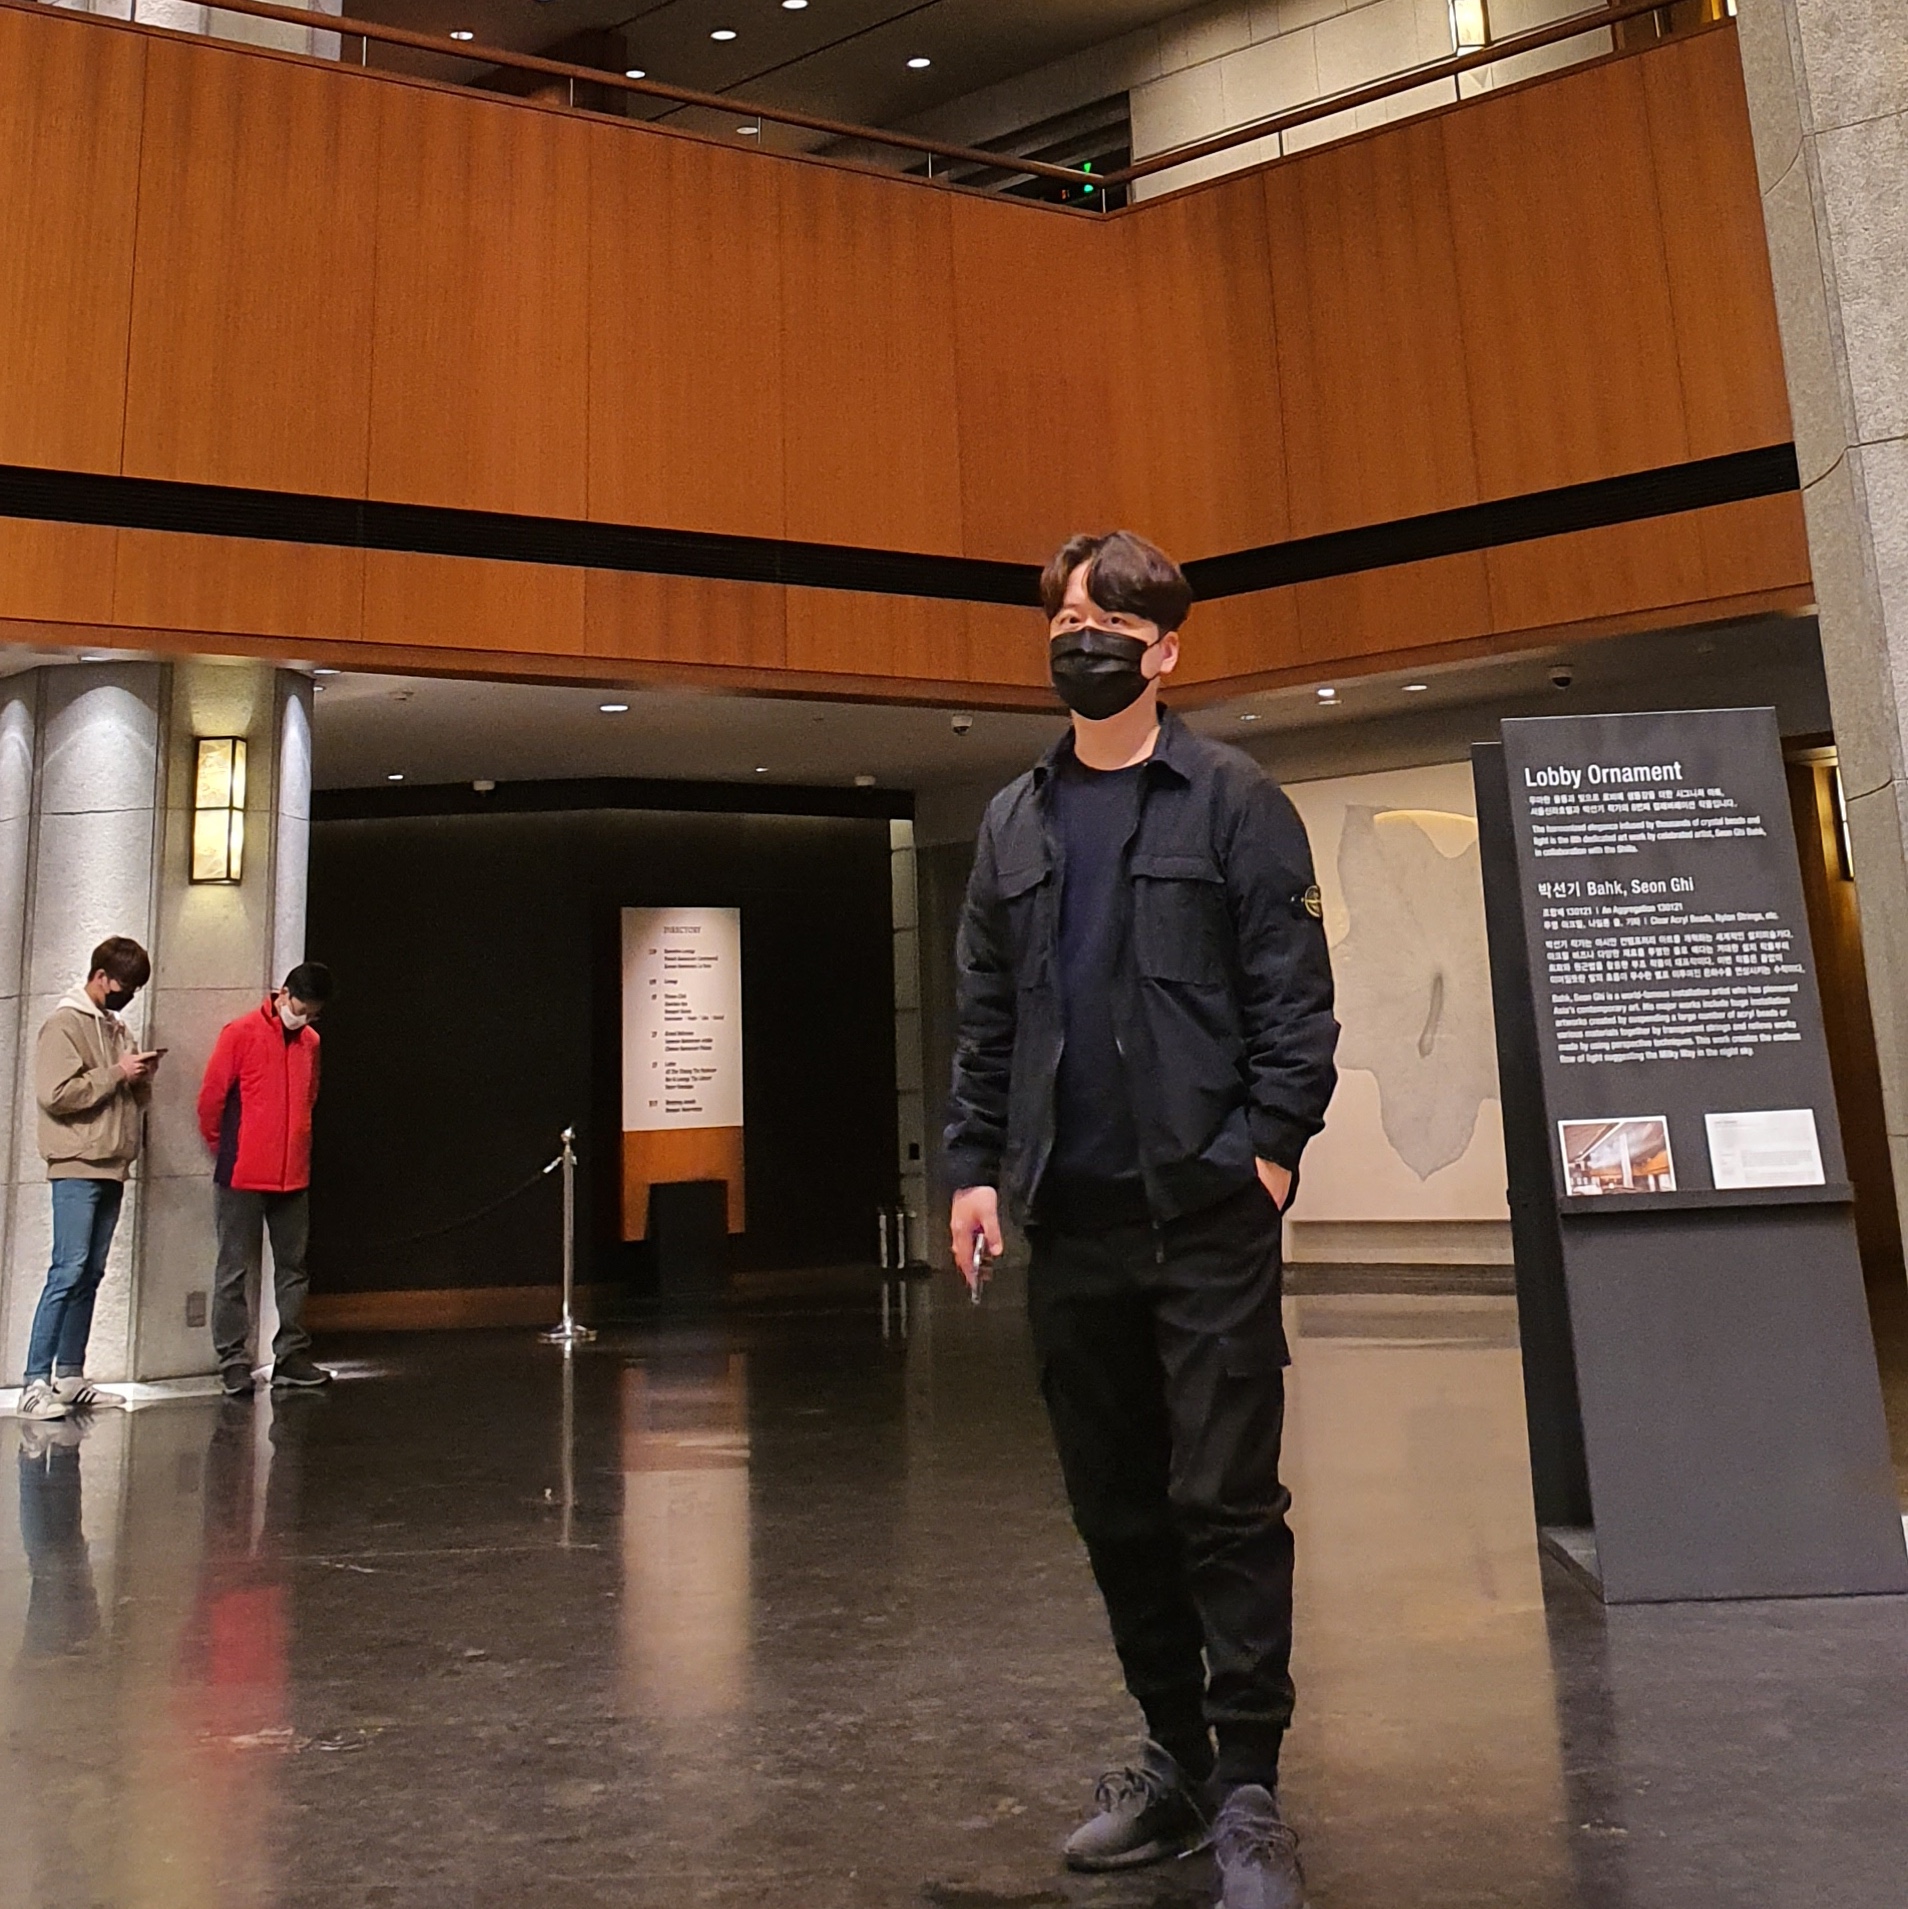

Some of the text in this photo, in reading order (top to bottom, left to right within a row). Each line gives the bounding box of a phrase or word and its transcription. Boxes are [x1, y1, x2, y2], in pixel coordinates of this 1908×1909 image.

[1524, 761, 1683, 790] Lobby Ornament
[1538, 876, 1694, 899] 박선기 Bahk, Seon Ghi
